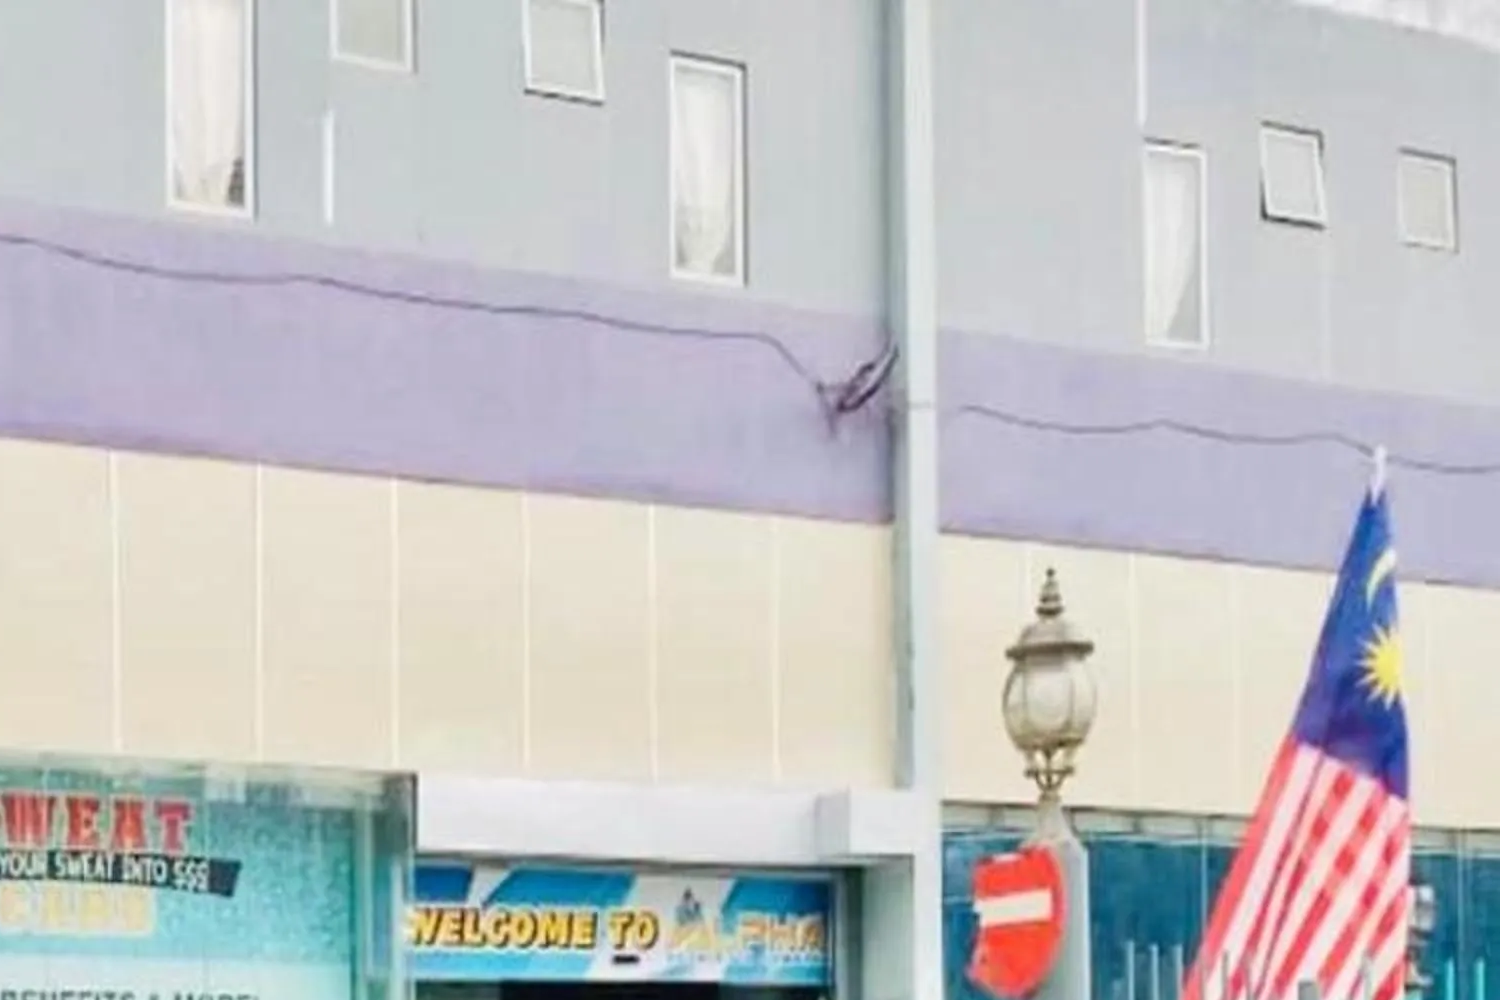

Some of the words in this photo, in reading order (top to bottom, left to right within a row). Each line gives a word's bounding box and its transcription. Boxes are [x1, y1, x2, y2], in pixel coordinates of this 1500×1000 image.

[54, 852, 115, 880] SWEAT
[122, 855, 167, 884] INTO
[406, 906, 597, 951] WELCOME
[611, 911, 660, 951] TO
